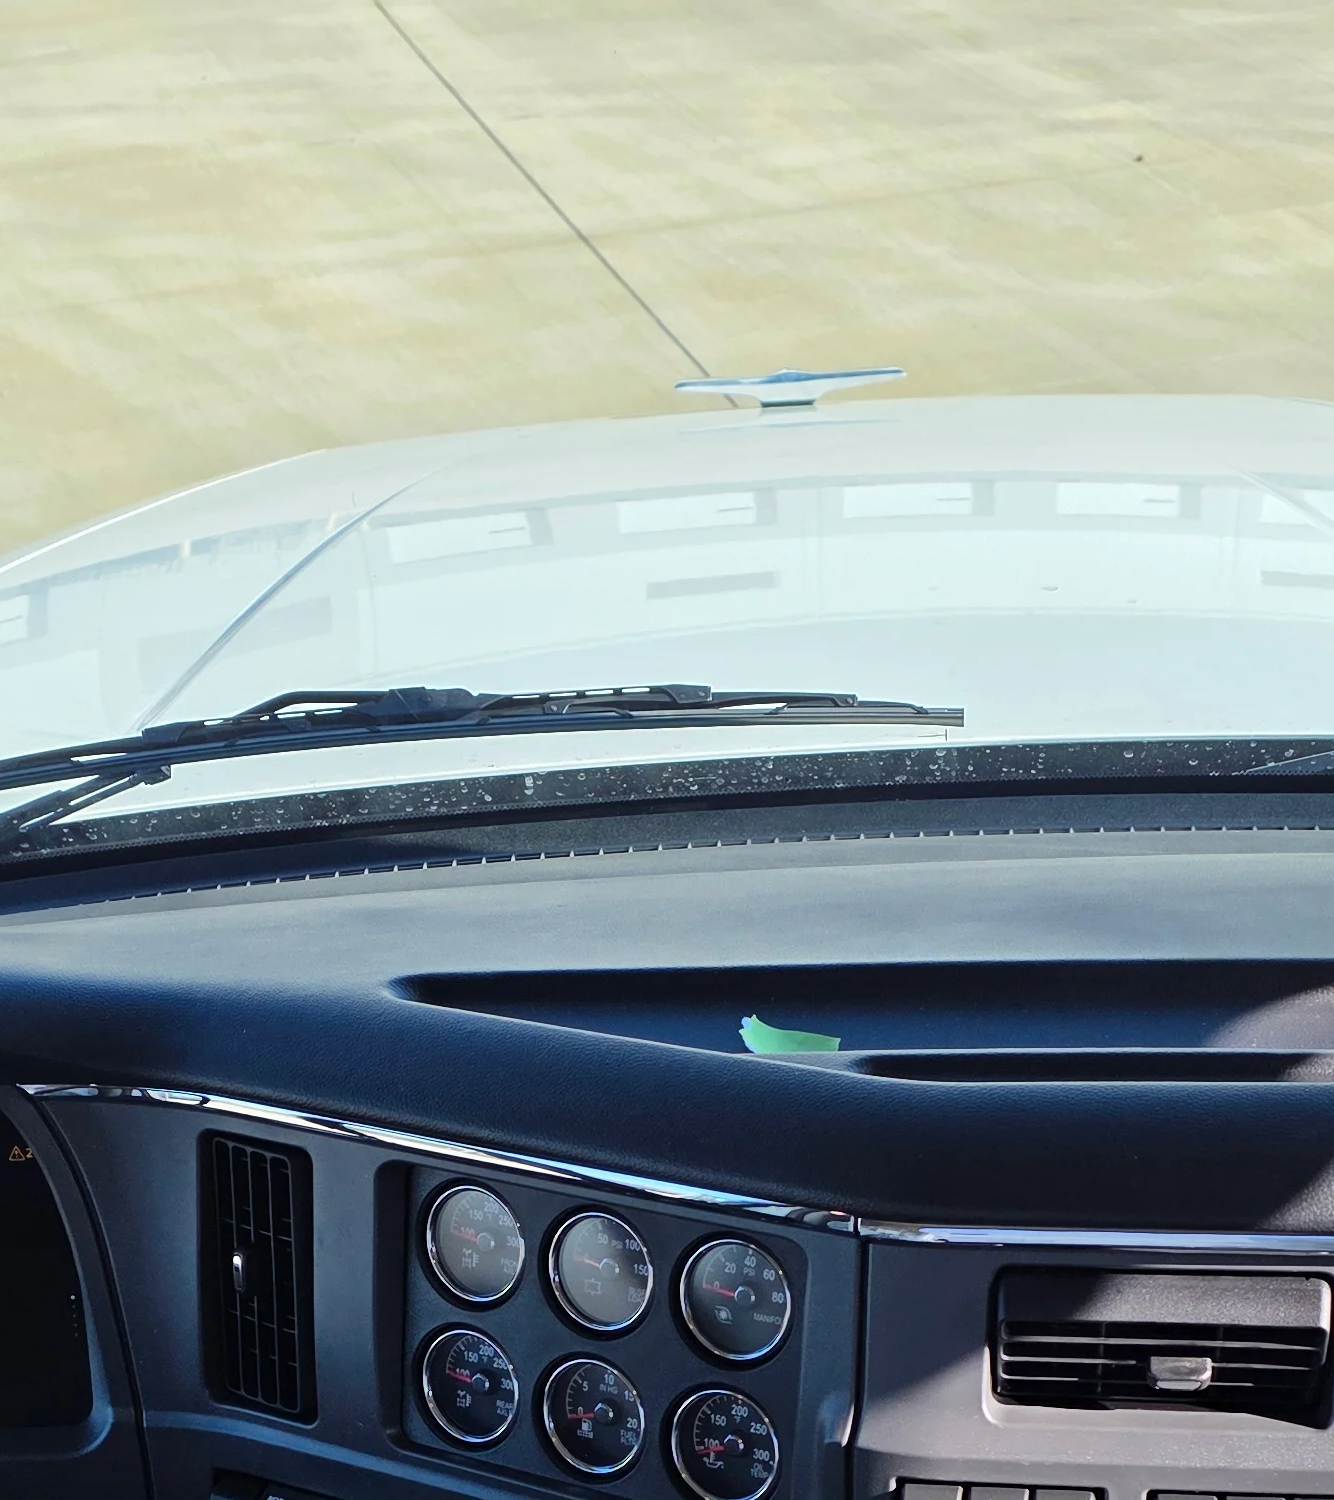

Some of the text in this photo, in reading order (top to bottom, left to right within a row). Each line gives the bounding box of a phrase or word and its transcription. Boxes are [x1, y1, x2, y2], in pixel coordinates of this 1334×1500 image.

[469, 1208, 484, 1221] 150
[597, 1232, 608, 1245] 50
[724, 1261, 737, 1274] 20
[744, 1255, 757, 1268] 40
[762, 1268, 776, 1282] 60
[771, 1290, 784, 1304] 80
[464, 1350, 479, 1363] 150
[479, 1344, 495, 1358] 200
[582, 1379, 589, 1392] 5
[604, 1372, 615, 1385] 10
[730, 1403, 749, 1418] 200
[625, 1416, 638, 1431] 20
[710, 1413, 727, 1428] 150
[749, 1421, 767, 1436] 250
[752, 1447, 771, 1462] 300
